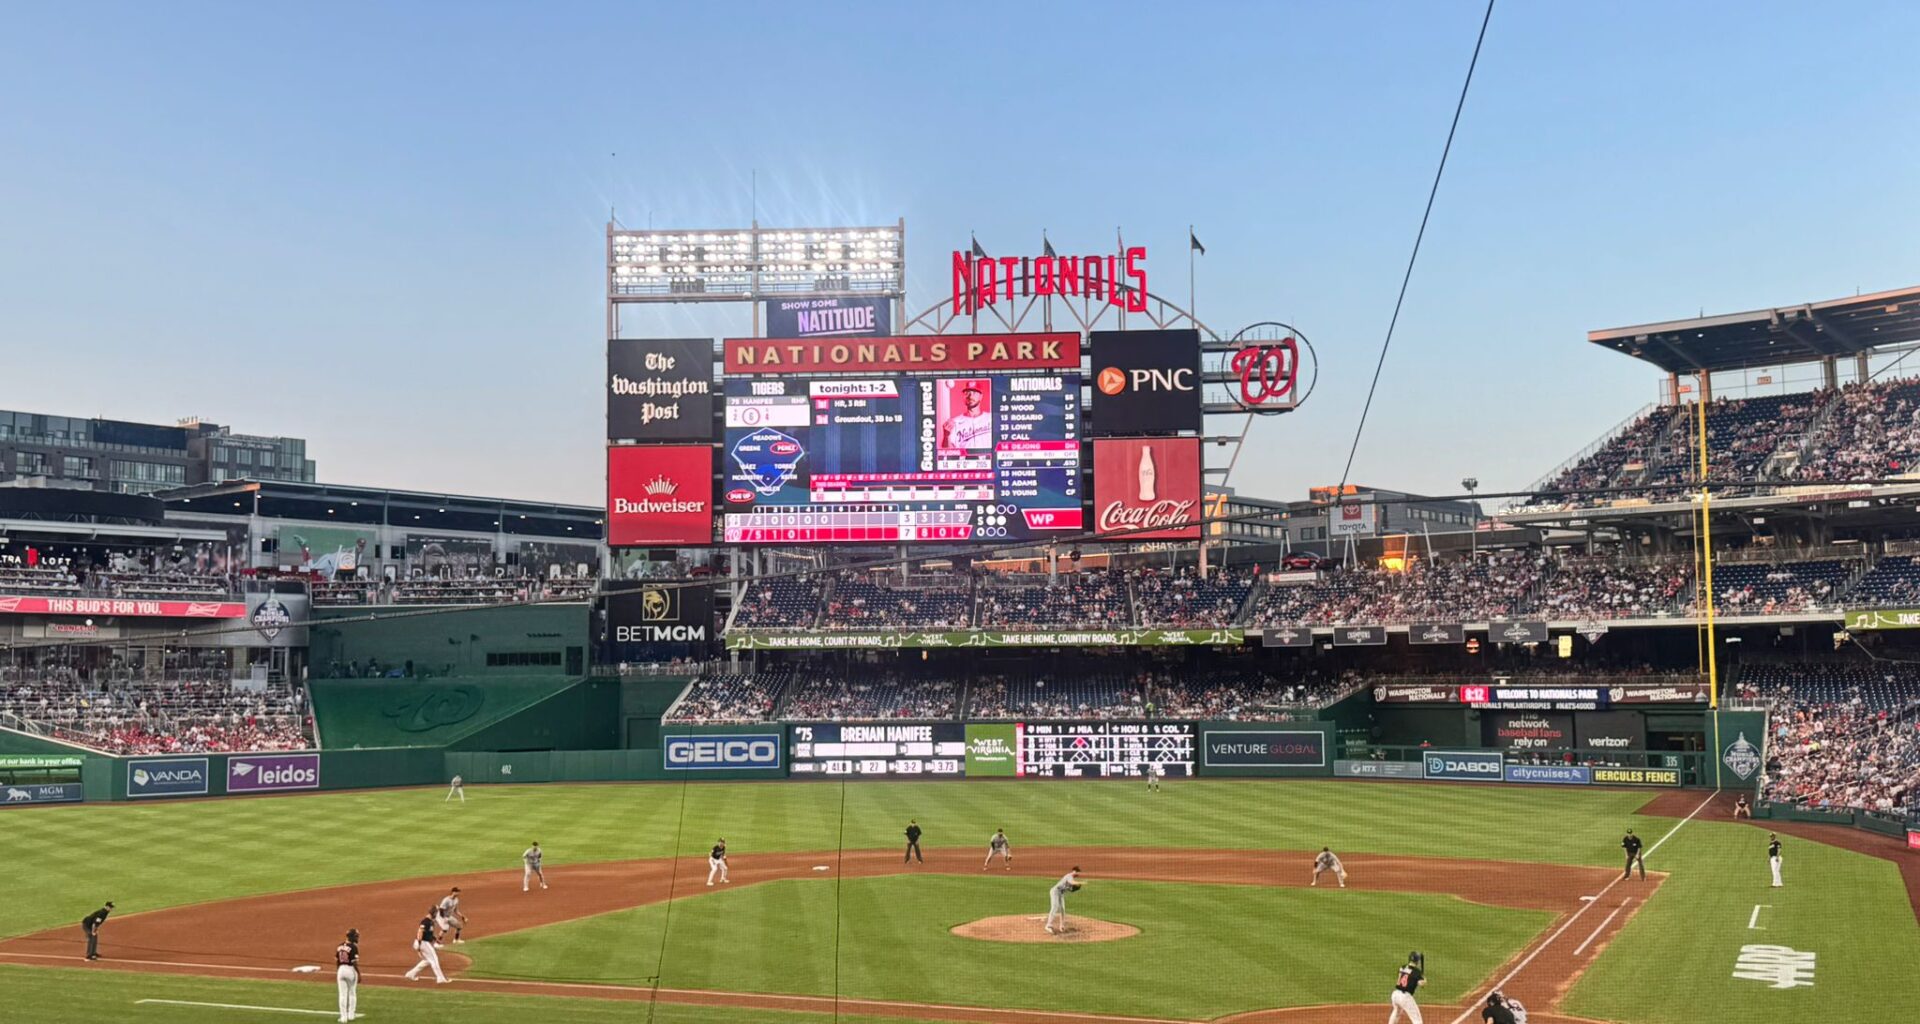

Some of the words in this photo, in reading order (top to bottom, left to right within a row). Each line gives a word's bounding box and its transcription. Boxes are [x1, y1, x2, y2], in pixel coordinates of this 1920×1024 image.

[953, 247, 1146, 316] NATIONALS
[781, 301, 809, 310] SHOW
[812, 299, 838, 308] SOME
[798, 306, 876, 333] NATITUDE
[737, 343, 947, 365] NATIONALS
[967, 340, 1061, 361] PARK
[645, 352, 676, 372] The
[1010, 377, 1062, 391] NATIONALS
[1129, 368, 1194, 391] PNC
[611, 373, 709, 399] Washington
[751, 381, 785, 396] TIGERS
[820, 384, 867, 394] tonight:
[869, 384, 887, 393] 1-2
[920, 382, 935, 415] paul
[641, 402, 680, 425] Post
[834, 415, 874, 423] Groundout,
[920, 418, 935, 471] dejong
[614, 498, 705, 513] Budweiser
[977, 505, 984, 515] B
[771, 516, 779, 525] 0
[788, 516, 795, 524] 0
[804, 516, 812, 524] 0
[821, 516, 828, 524] 0
[904, 514, 910, 522] 3
[921, 514, 928, 522] 3
[939, 514, 946, 522] 2
[958, 514, 964, 522] 3
[977, 517, 984, 526] S
[1030, 513, 1055, 525] WP
[1338, 523, 1366, 531] TOYOTA
[788, 530, 795, 539] 0
[904, 529, 910, 537] 7
[921, 528, 928, 537] 8
[939, 528, 946, 537] 0
[957, 528, 965, 537] 4
[42, 556, 71, 565] LOFT
[48, 600, 73, 612] THIS
[76, 600, 110, 613] BUD'S
[113, 602, 134, 613] FOR
[137, 602, 162, 614] YOU.
[617, 625, 705, 641] BETMGM
[769, 637, 787, 646] TAKE
[788, 637, 799, 646] ME
[800, 637, 823, 647] HOME,
[825, 636, 857, 646] COUNTRY
[858, 636, 881, 645] ROADS
[1002, 635, 1019, 643] TAKE
[1020, 635, 1032, 643] ME
[1033, 635, 1057, 644] HOME,
[1058, 634, 1091, 643] COUNTRY
[1092, 634, 1116, 643] ROADS
[1388, 687, 1431, 697] WASHINGTON
[1409, 692, 1446, 701] NATIONALS
[1465, 688, 1484, 701] 8:12
[1496, 689, 1528, 699] WELCOME
[1529, 689, 1539, 699] TO
[1540, 689, 1577, 699] NATIONALS
[1578, 689, 1598, 699] PARK
[1626, 688, 1676, 697] WASHINGTON
[1650, 692, 1692, 701] NATIONALS
[1121, 725, 1139, 733] HOU
[1142, 725, 1148, 733] 6
[1162, 725, 1179, 733] COL
[1184, 725, 1189, 733] 7
[1509, 720, 1549, 728] network
[841, 726, 885, 742] BRENAN
[887, 726, 932, 742] HANIFEE
[1498, 729, 1538, 737] baseball
[1540, 729, 1561, 737] fans
[1514, 737, 1532, 747] rely
[1589, 737, 1628, 746] verizon
[668, 741, 776, 763] GEICO
[966, 745, 1015, 755] VIRGINIA
[1212, 744, 1267, 754] VENTURE
[1269, 743, 1317, 754] GLOBAL
[869, 762, 878, 771] 27
[904, 762, 916, 771] 3-2
[938, 762, 953, 771] 3.73
[1446, 762, 1499, 772] DABOS
[1665, 756, 1678, 767] 335
[150, 770, 202, 782] VANDA
[258, 765, 315, 784] leidos
[1513, 768, 1569, 779] citycruises
[1595, 770, 1643, 782] HERCULES
[1646, 771, 1676, 783] FENCE
[40, 786, 63, 795] MGM
